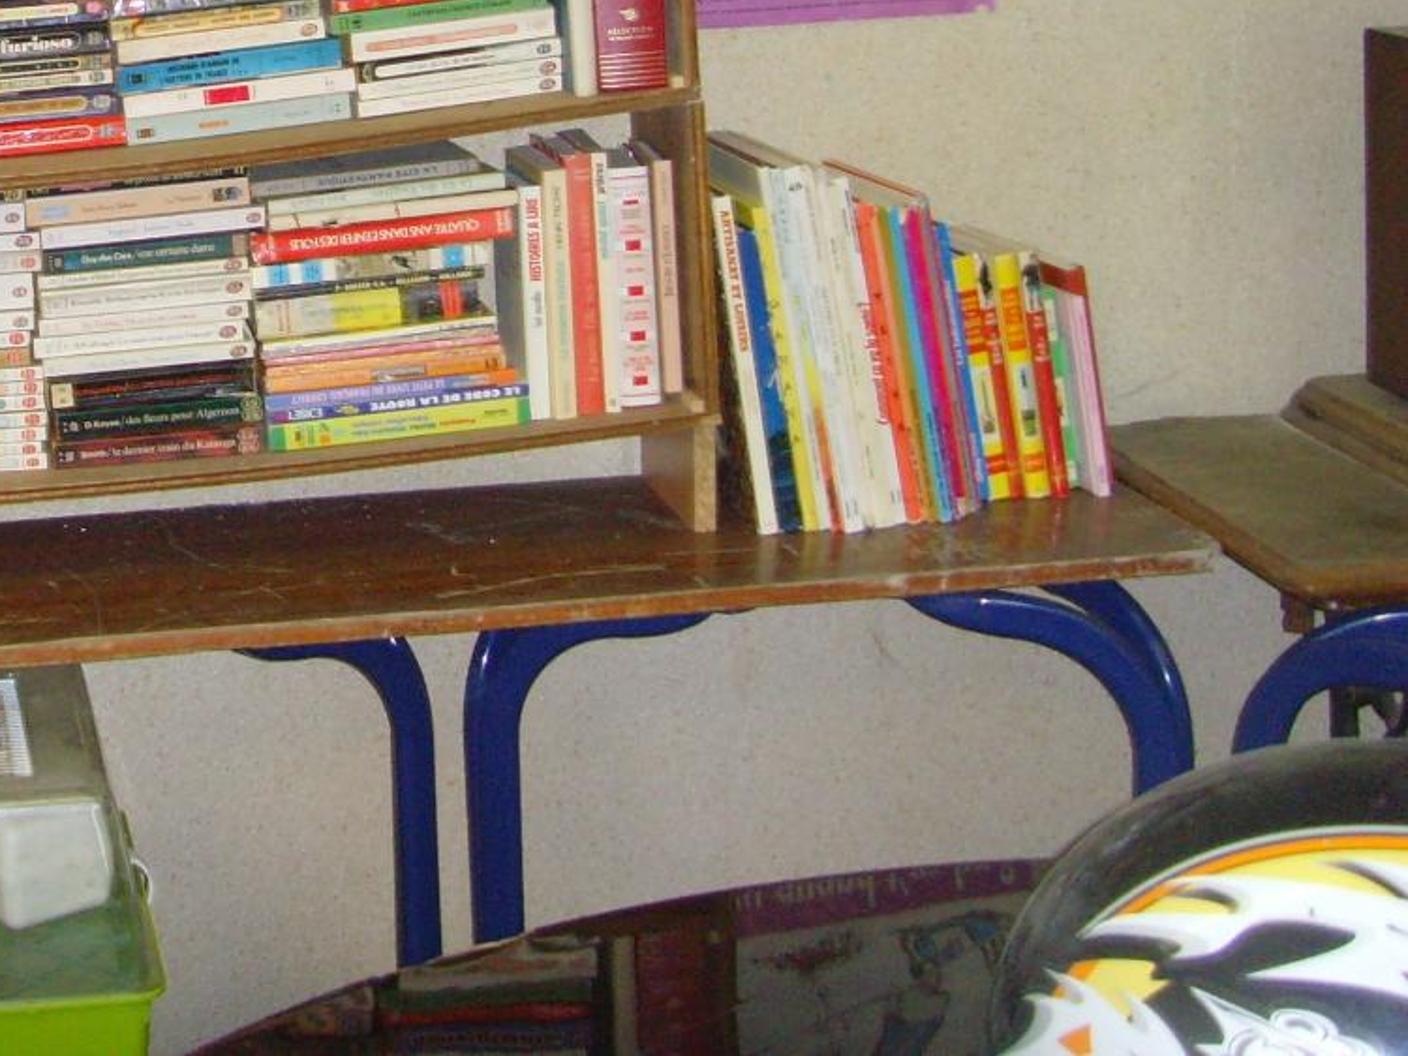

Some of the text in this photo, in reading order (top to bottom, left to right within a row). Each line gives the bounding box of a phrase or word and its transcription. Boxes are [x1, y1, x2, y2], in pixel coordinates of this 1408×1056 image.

[0, 35, 74, 55] furioso
[378, 225, 409, 239] DANS
[410, 223, 432, 236] ANS
[432, 217, 480, 234] QUATRE
[291, 235, 318, 250] FOUS
[317, 232, 339, 246] DES
[527, 231, 542, 282] HISTOIRES
[370, 385, 522, 413] LE CODE DE LA ROUTE
